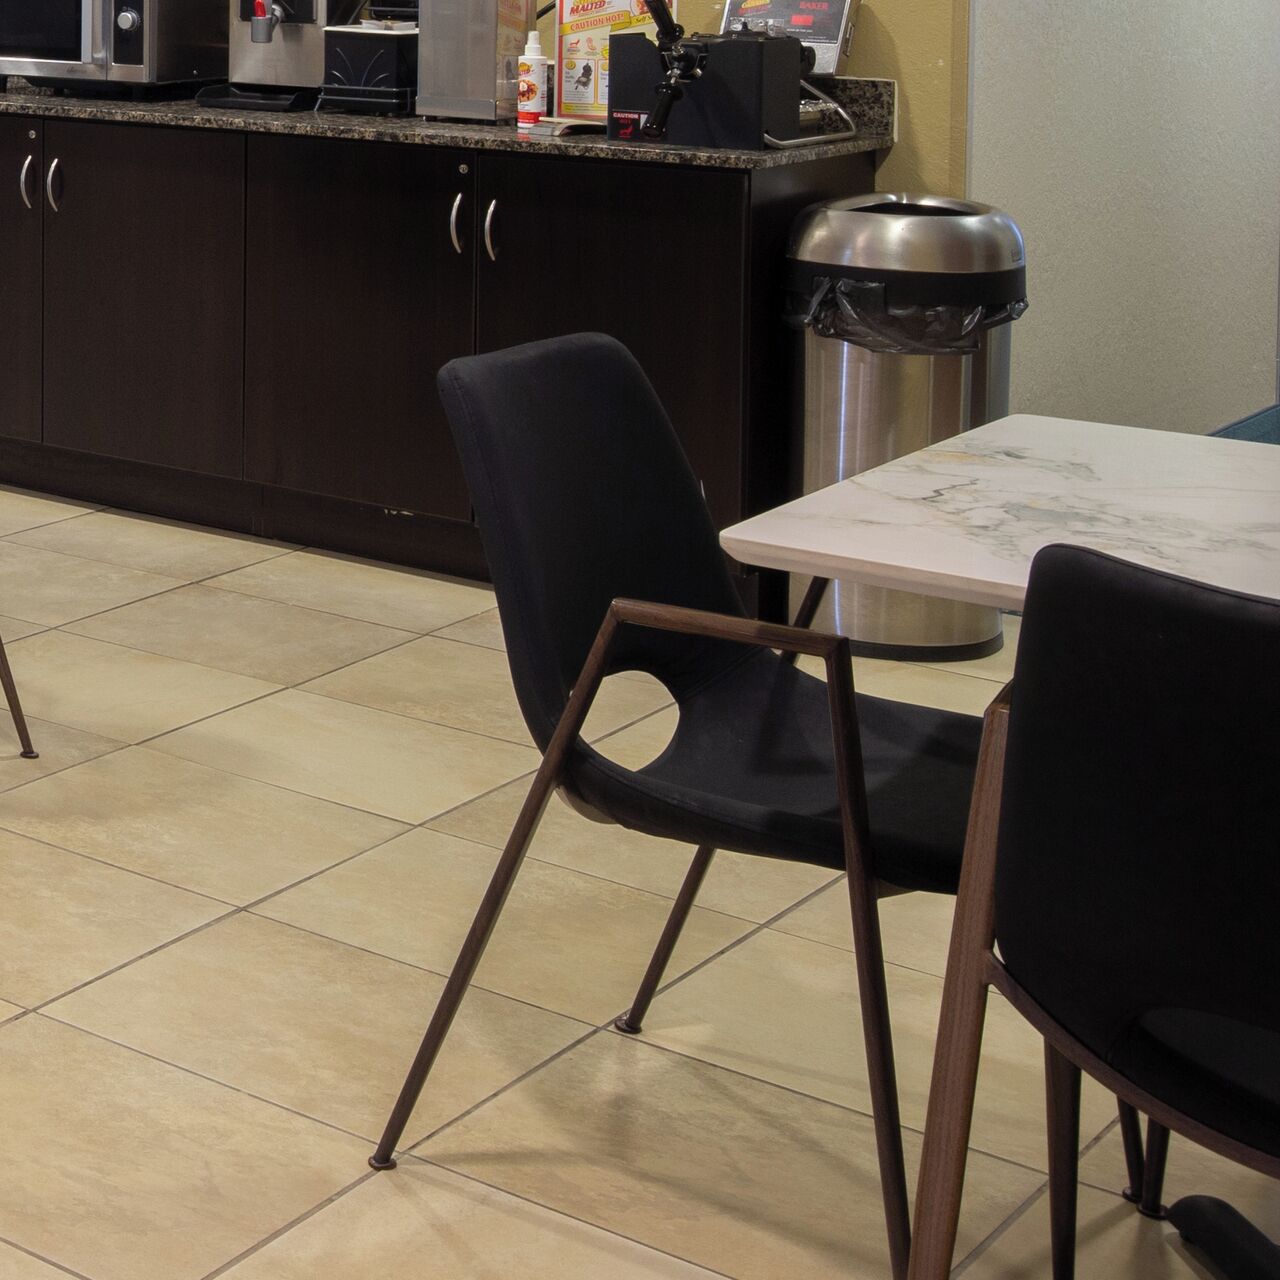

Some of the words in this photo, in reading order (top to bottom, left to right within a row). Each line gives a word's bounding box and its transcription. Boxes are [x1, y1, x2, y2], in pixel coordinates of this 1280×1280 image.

[570, 0, 606, 15] MALTED
[570, 18, 604, 32] CAUTION
[605, 13, 625, 24] HOT!
[613, 111, 639, 119] CAUTION
